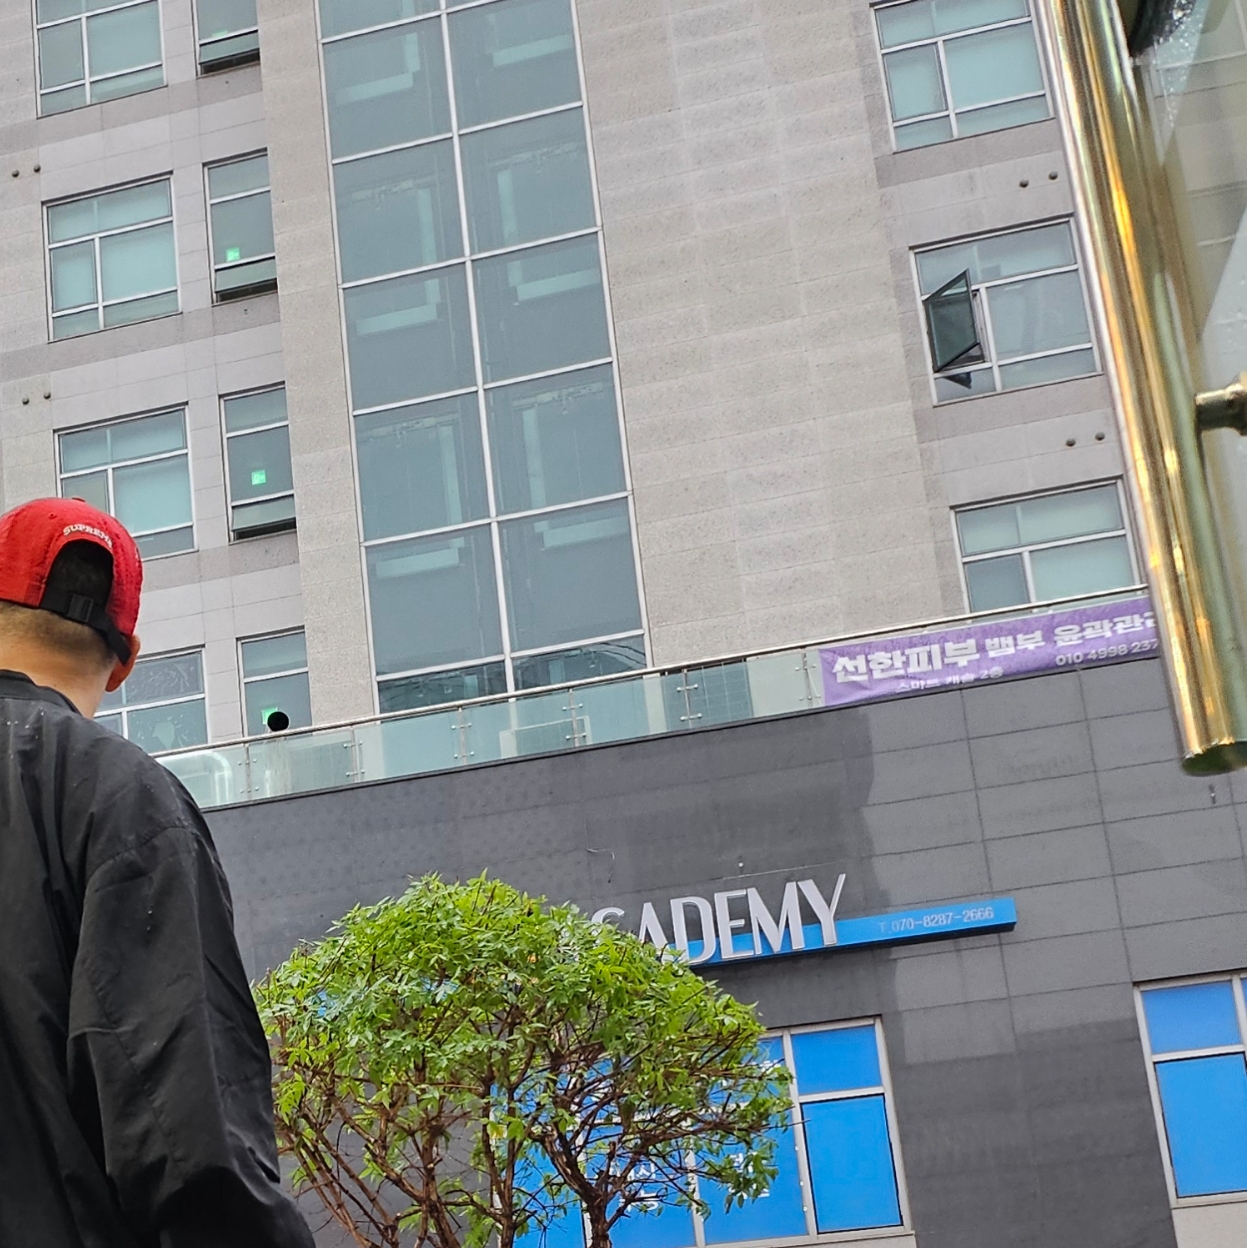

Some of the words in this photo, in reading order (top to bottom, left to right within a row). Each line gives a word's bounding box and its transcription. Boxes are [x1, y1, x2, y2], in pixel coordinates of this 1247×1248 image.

[832, 637, 981, 684] 선한피부
[1055, 652, 1084, 666] 010
[1087, 643, 1129, 660] 4998
